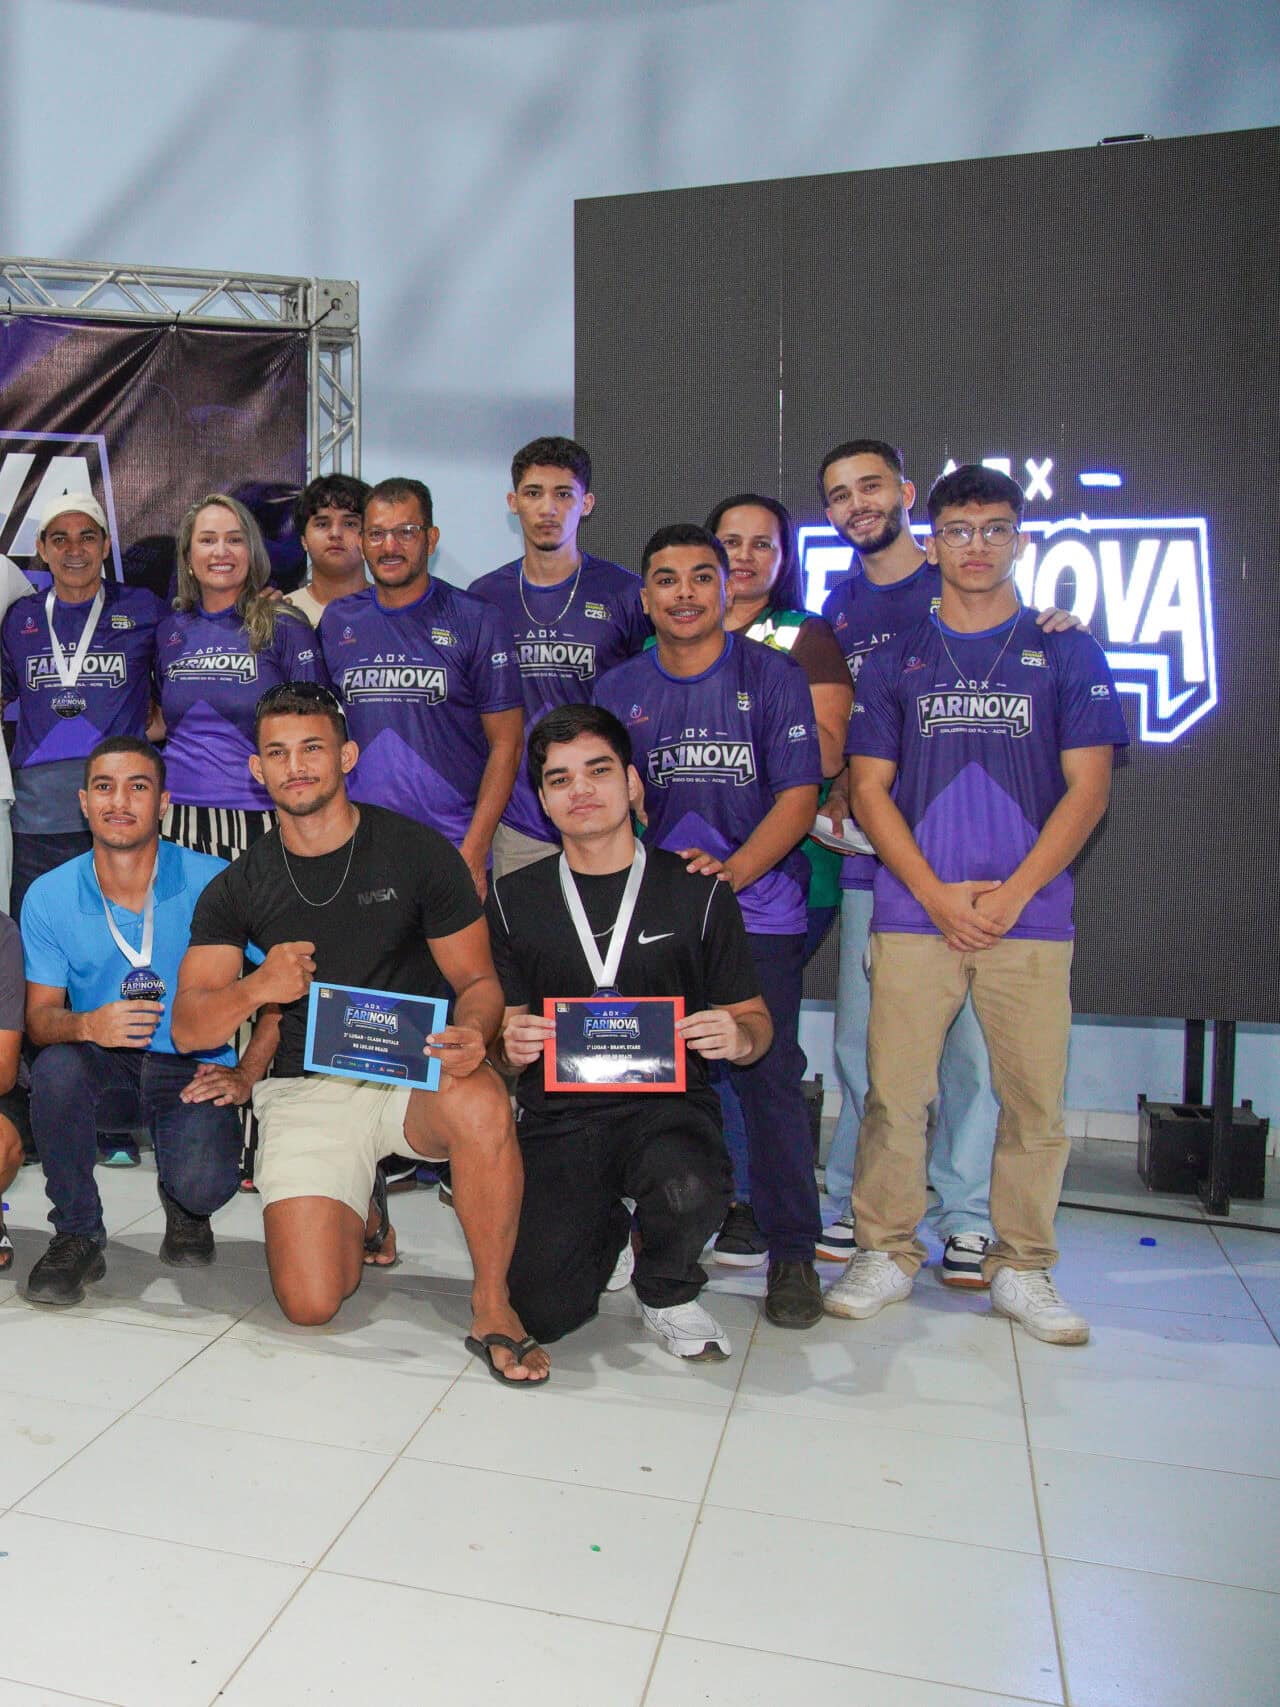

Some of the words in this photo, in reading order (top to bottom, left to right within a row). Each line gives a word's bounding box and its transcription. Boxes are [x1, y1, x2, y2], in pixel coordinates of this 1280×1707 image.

[344, 667, 446, 697] FARINOVA
[920, 694, 1029, 726] FARINOVA
[121, 981, 165, 994] FARINOVA
[346, 1007, 398, 1030] FARINOVA
[585, 1019, 639, 1036] FARINOVA
